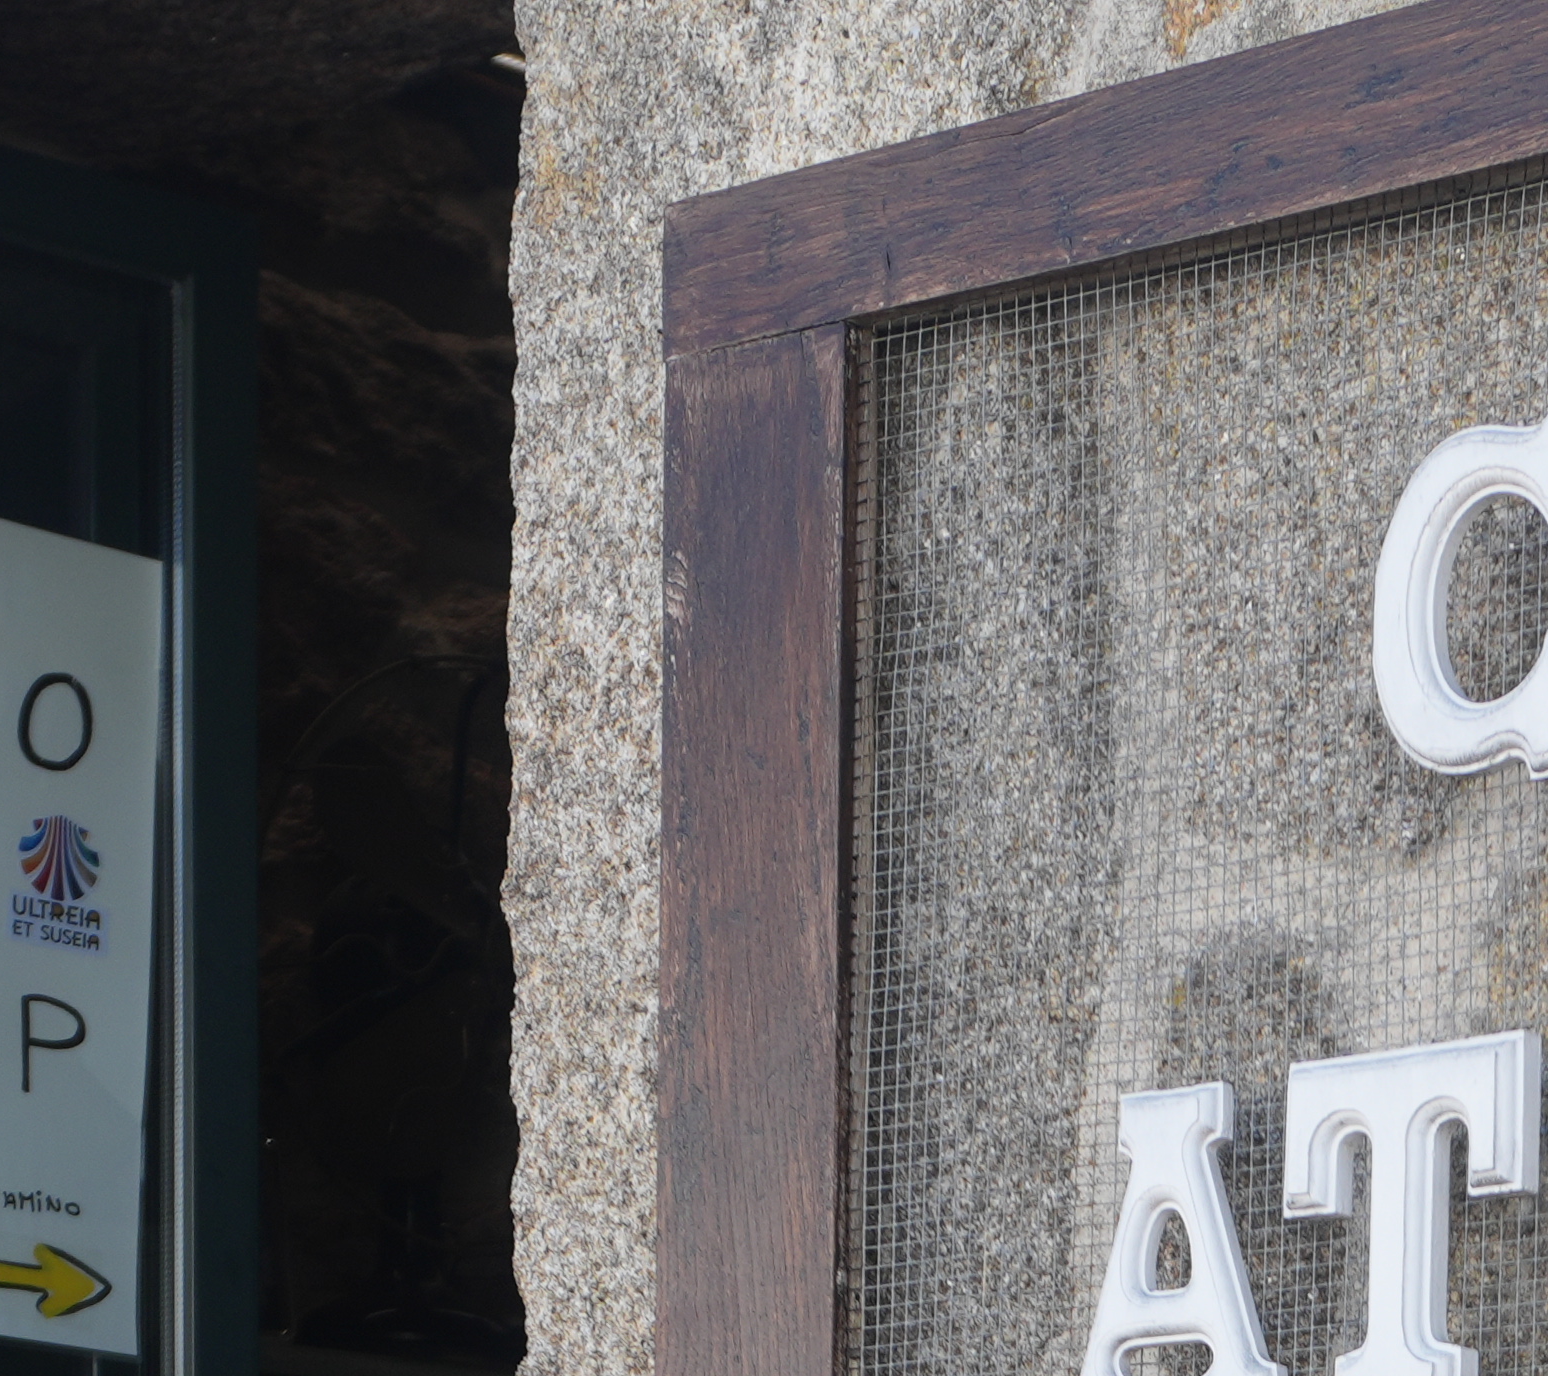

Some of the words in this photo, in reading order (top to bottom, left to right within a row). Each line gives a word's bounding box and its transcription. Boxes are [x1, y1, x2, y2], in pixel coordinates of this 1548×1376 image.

[13, 894, 101, 930] ULTREIA
[13, 919, 34, 937] ET
[40, 925, 100, 951] SUSEIA
